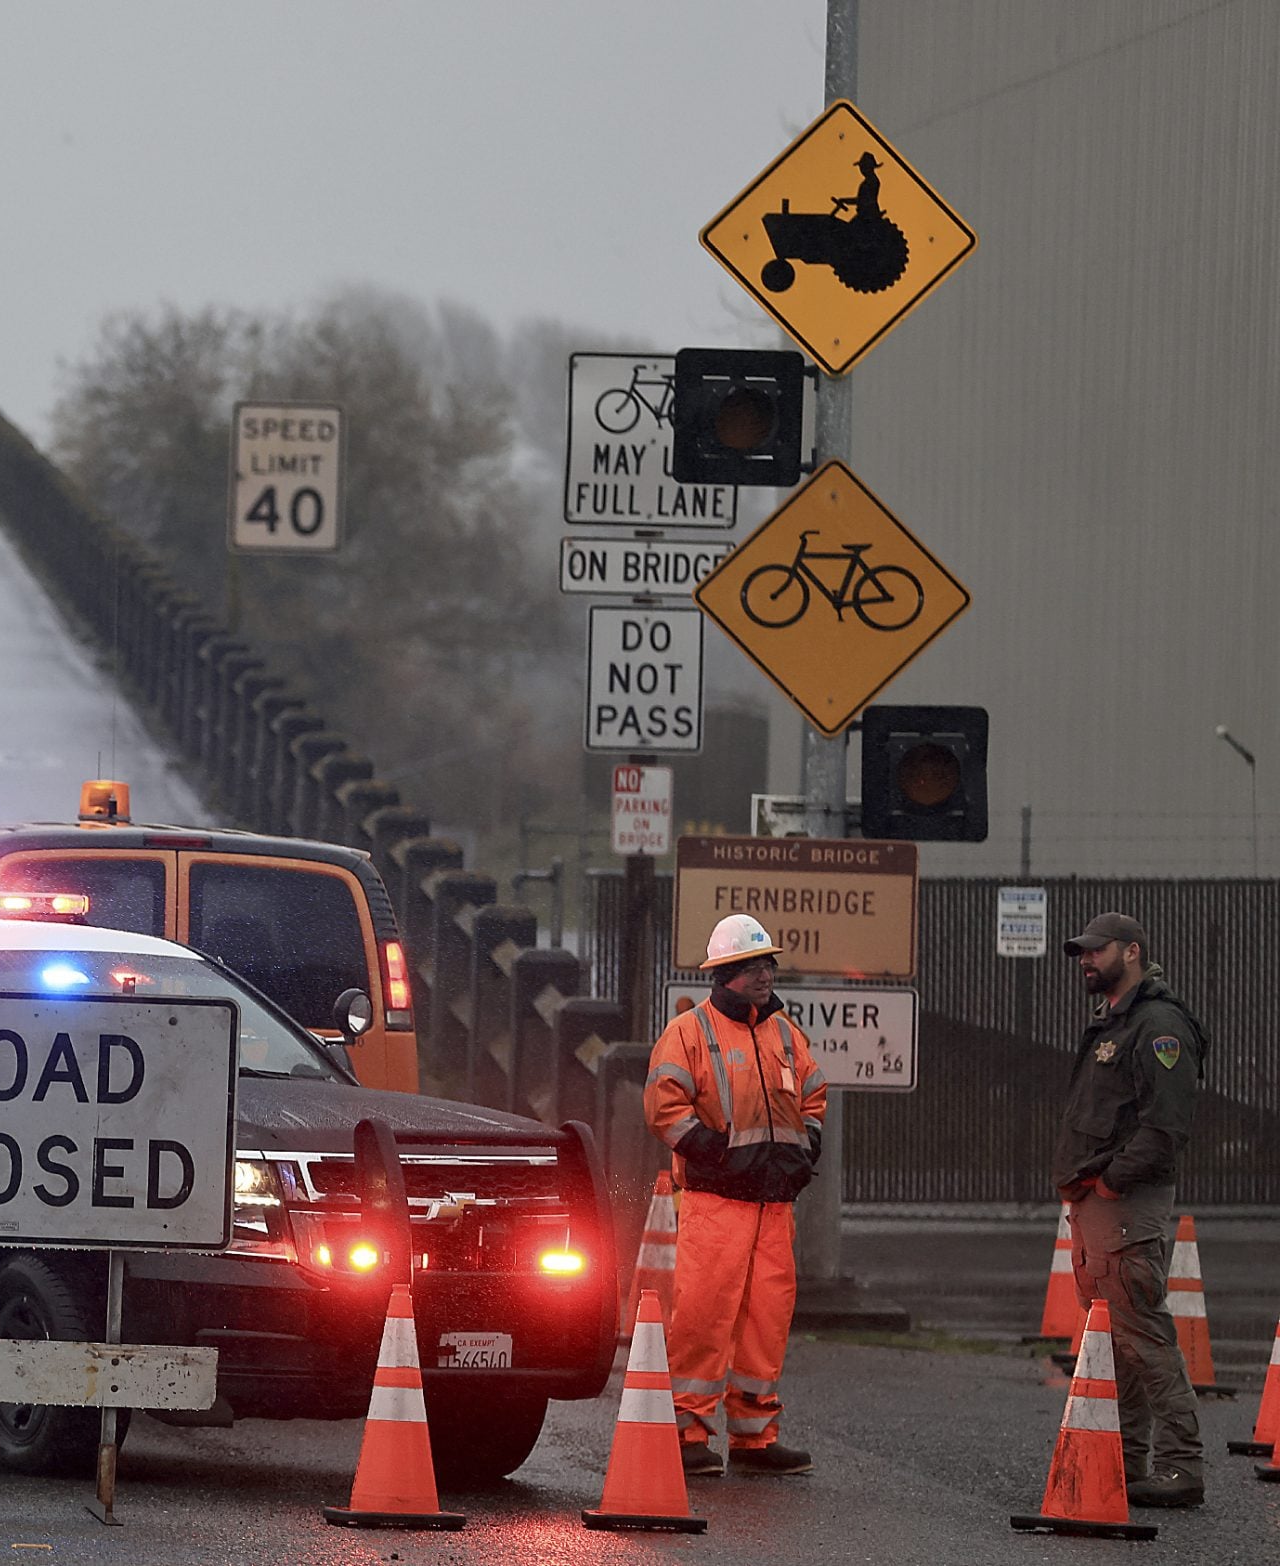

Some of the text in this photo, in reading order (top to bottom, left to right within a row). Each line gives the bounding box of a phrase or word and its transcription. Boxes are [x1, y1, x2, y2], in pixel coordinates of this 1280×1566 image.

[243, 417, 336, 442] SPEED
[250, 453, 322, 475] LIMIT
[593, 443, 646, 476] MAY
[245, 484, 324, 537] 40
[576, 483, 726, 518] FULL LANE
[568, 550, 725, 584] ON BRIDG
[622, 620, 671, 652] DO
[609, 662, 683, 695] NOT
[596, 705, 693, 738] PASS
[618, 769, 639, 790] NO
[616, 799, 669, 816] PARKING
[633, 818, 650, 830] ON
[619, 832, 663, 847] BRIDGE
[713, 846, 880, 865] HISTORIC BRIDGE
[715, 886, 876, 917] FERNBRIDGE
[778, 928, 820, 954] 1911
[787, 1001, 879, 1029] RIVER
[855, 1054, 903, 1078] 78 56
